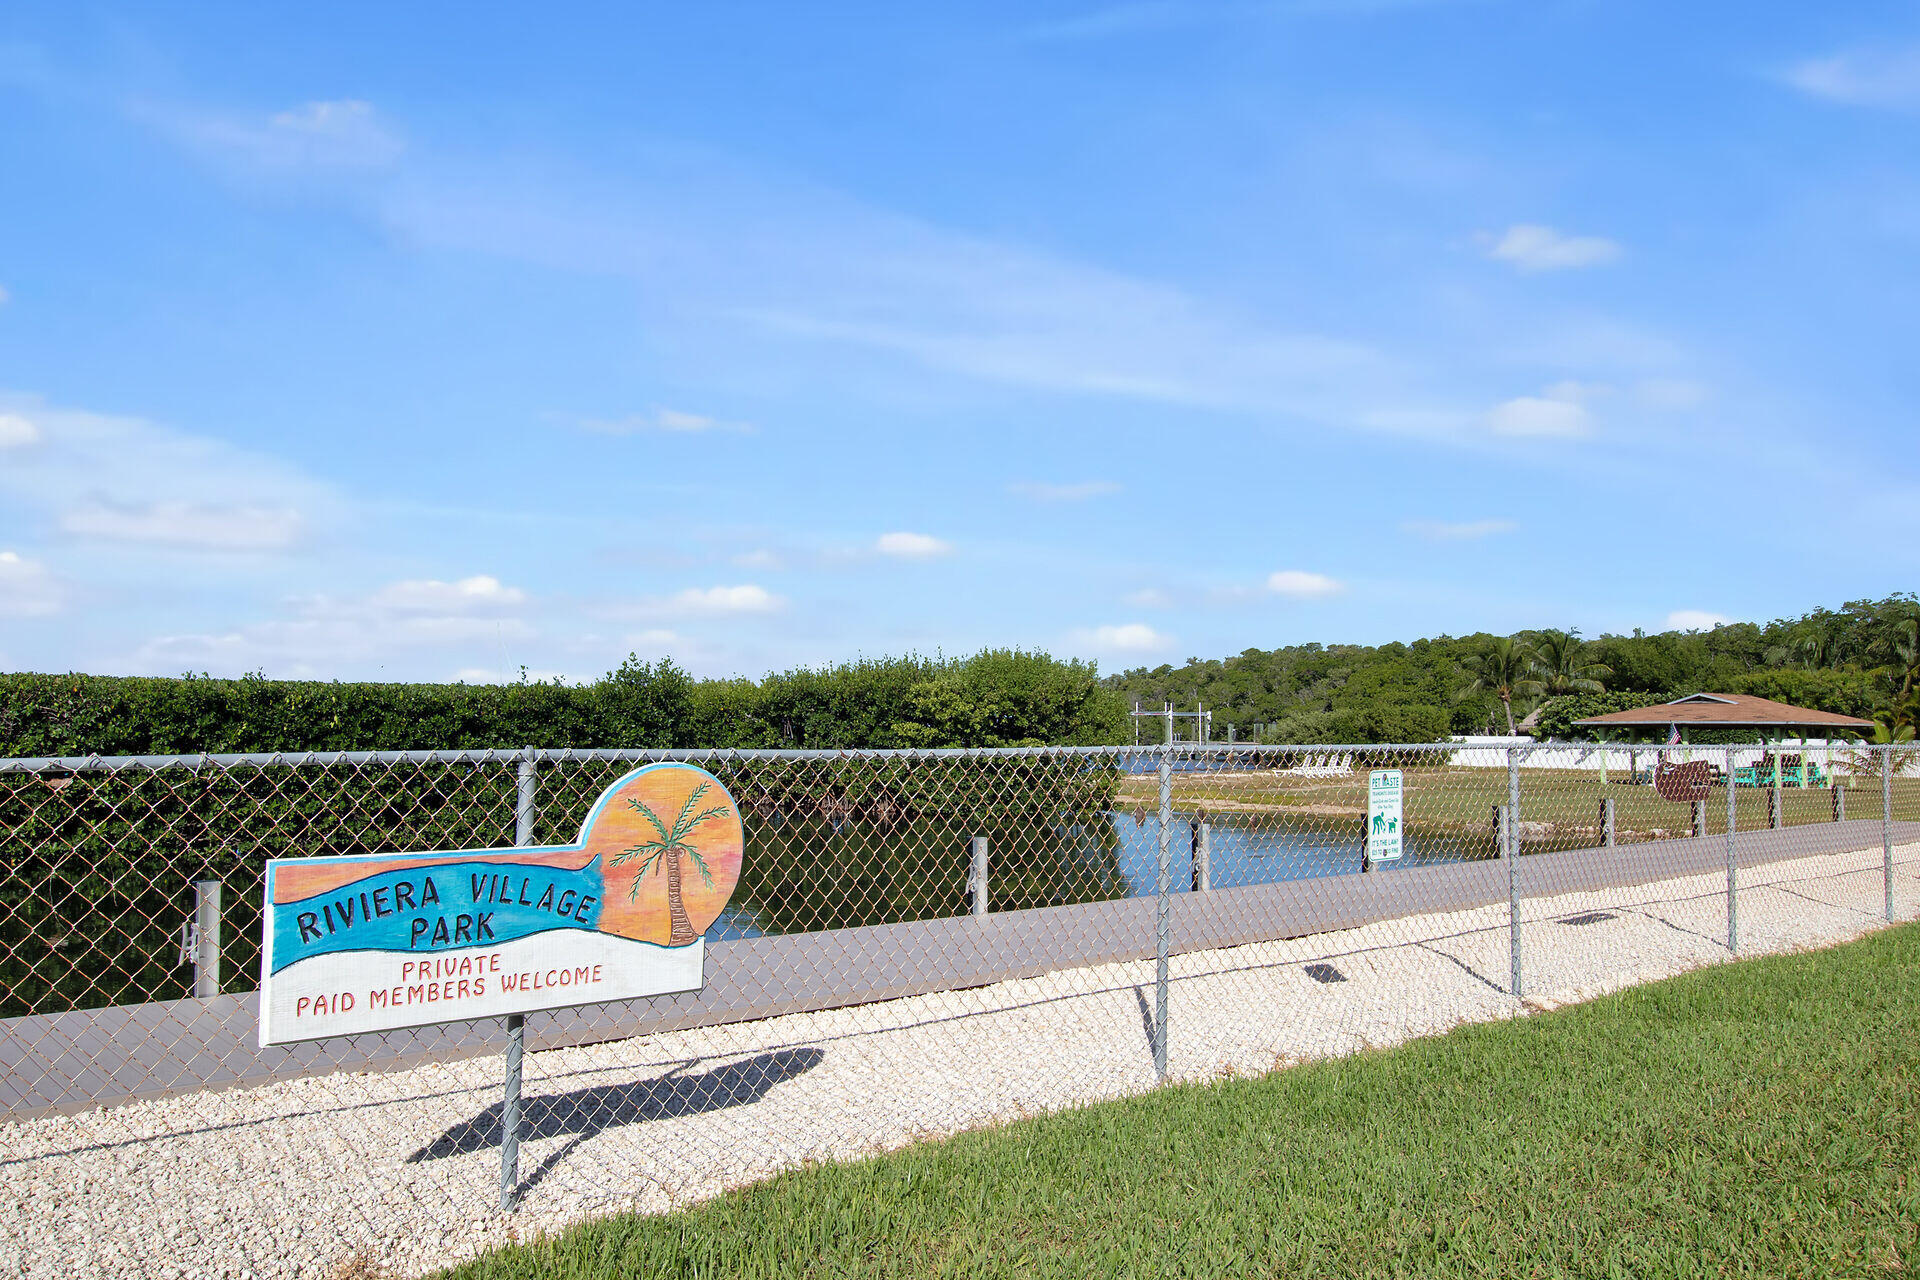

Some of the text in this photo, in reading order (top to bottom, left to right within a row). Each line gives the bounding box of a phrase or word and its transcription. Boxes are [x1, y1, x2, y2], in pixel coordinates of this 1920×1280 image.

[1372, 778, 1381, 787] PET
[297, 873, 597, 944] RIVIERA VILLAGE
[411, 912, 496, 948] PARK
[402, 953, 501, 982] PRIVATE
[296, 964, 603, 1017] PAID MEMBERS WELCOME
